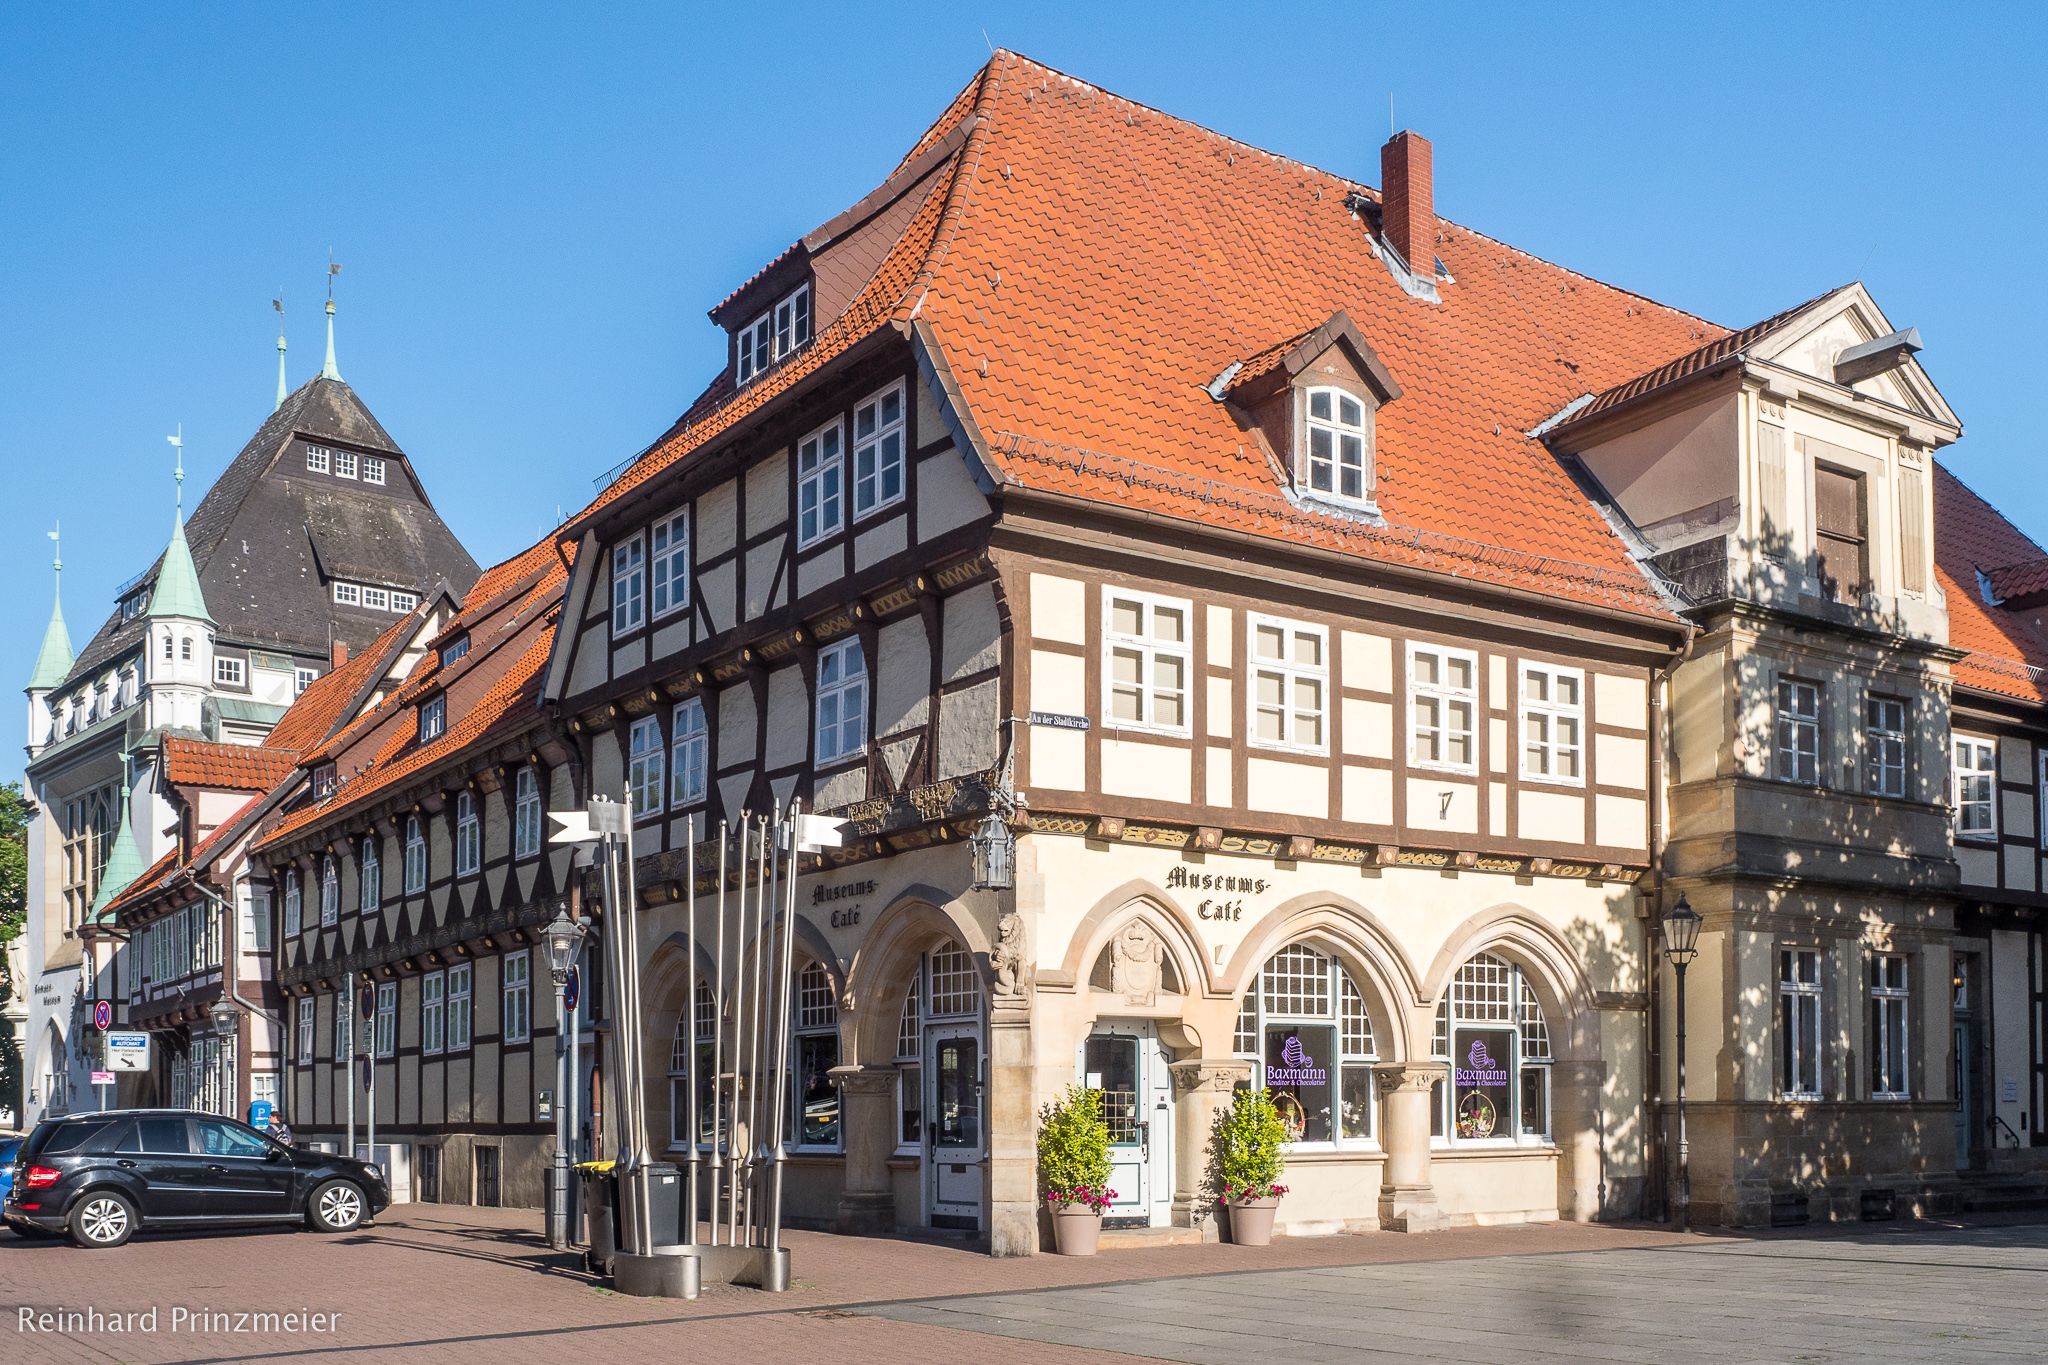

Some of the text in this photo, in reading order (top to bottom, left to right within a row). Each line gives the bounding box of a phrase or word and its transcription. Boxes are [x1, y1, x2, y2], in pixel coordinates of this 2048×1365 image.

[1032, 713, 1089, 729] An der Stadtkirche
[1166, 866, 1271, 894] Museums-
[812, 880, 879, 905] Museums-
[831, 904, 860, 928] Café
[1198, 899, 1242, 921] Café
[1267, 1065, 1326, 1080] Baxmann
[1456, 1067, 1507, 1080] Baxmann
[257, 1108, 266, 1117] P
